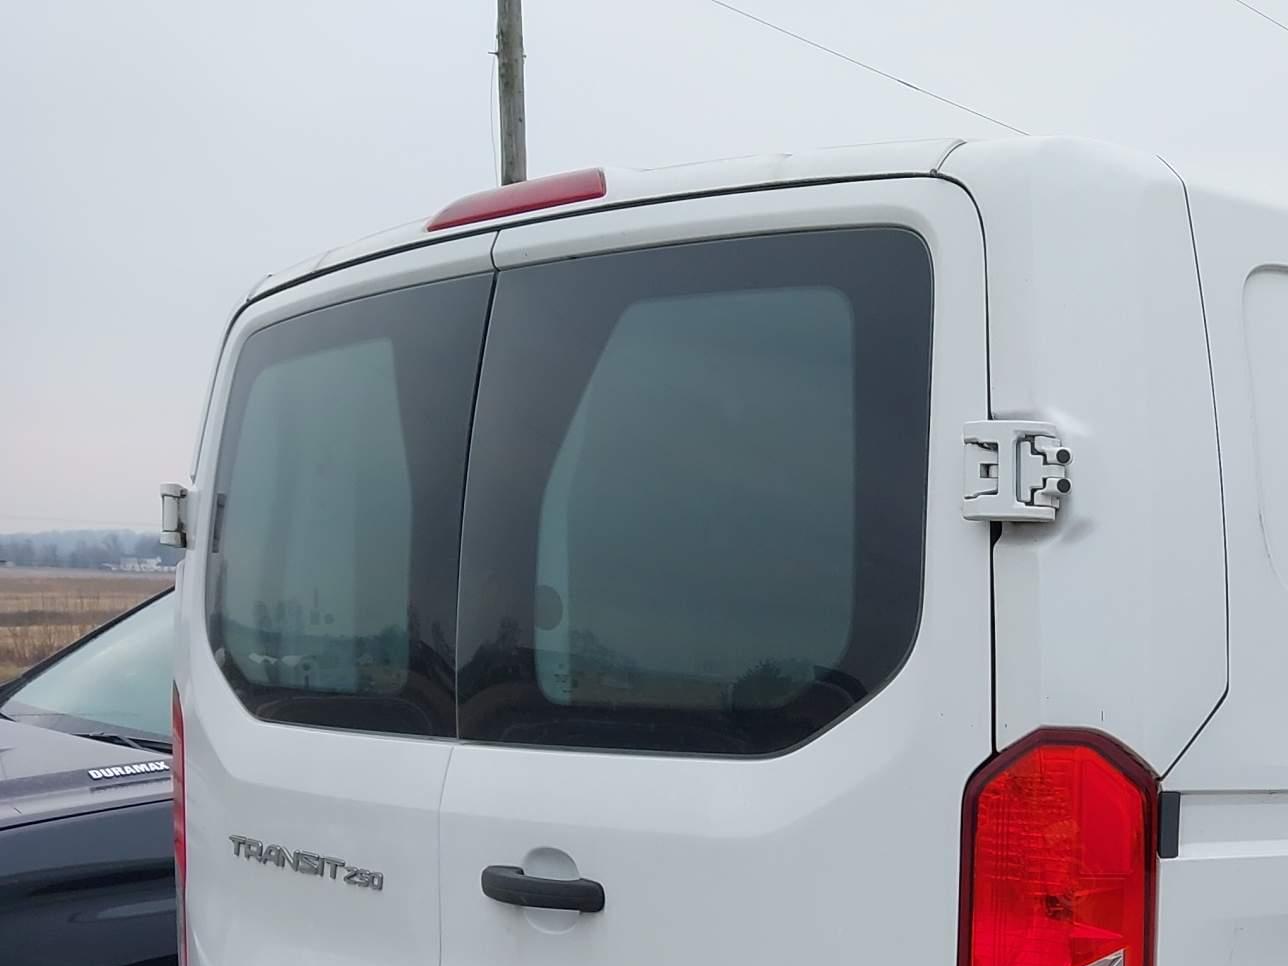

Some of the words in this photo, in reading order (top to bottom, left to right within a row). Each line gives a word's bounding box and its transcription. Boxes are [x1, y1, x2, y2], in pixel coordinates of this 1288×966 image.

[88, 761, 170, 780] DURAMAX
[228, 834, 346, 880] TRANSIT
[343, 866, 384, 890] 250
